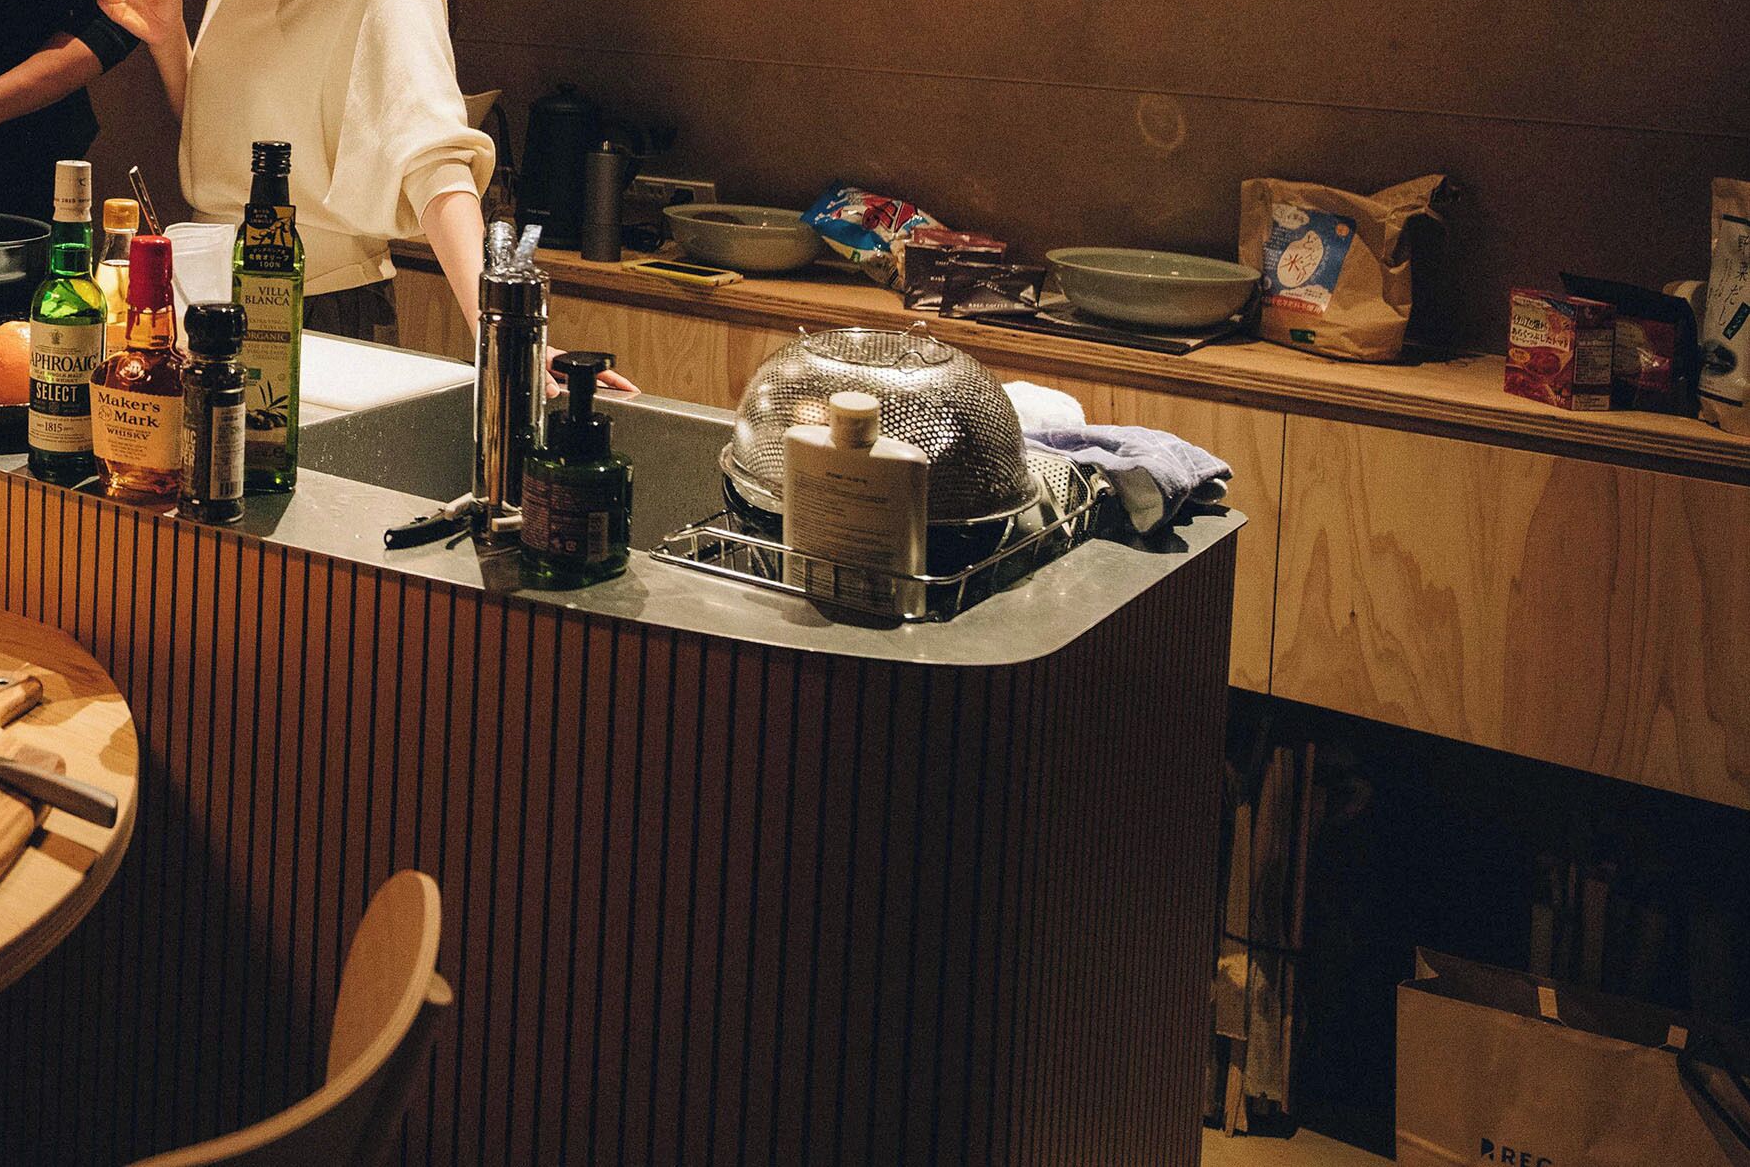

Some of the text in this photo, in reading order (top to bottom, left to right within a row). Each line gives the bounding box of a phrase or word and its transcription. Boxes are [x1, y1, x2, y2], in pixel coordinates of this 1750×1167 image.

[259, 286, 290, 296] VILLA
[245, 295, 290, 306] BLANCA
[36, 382, 78, 403] SELECT
[98, 392, 161, 413] Maker's
[114, 410, 160, 428] Mark
[44, 421, 63, 433] 1815
[106, 427, 151, 440] WHISKY
